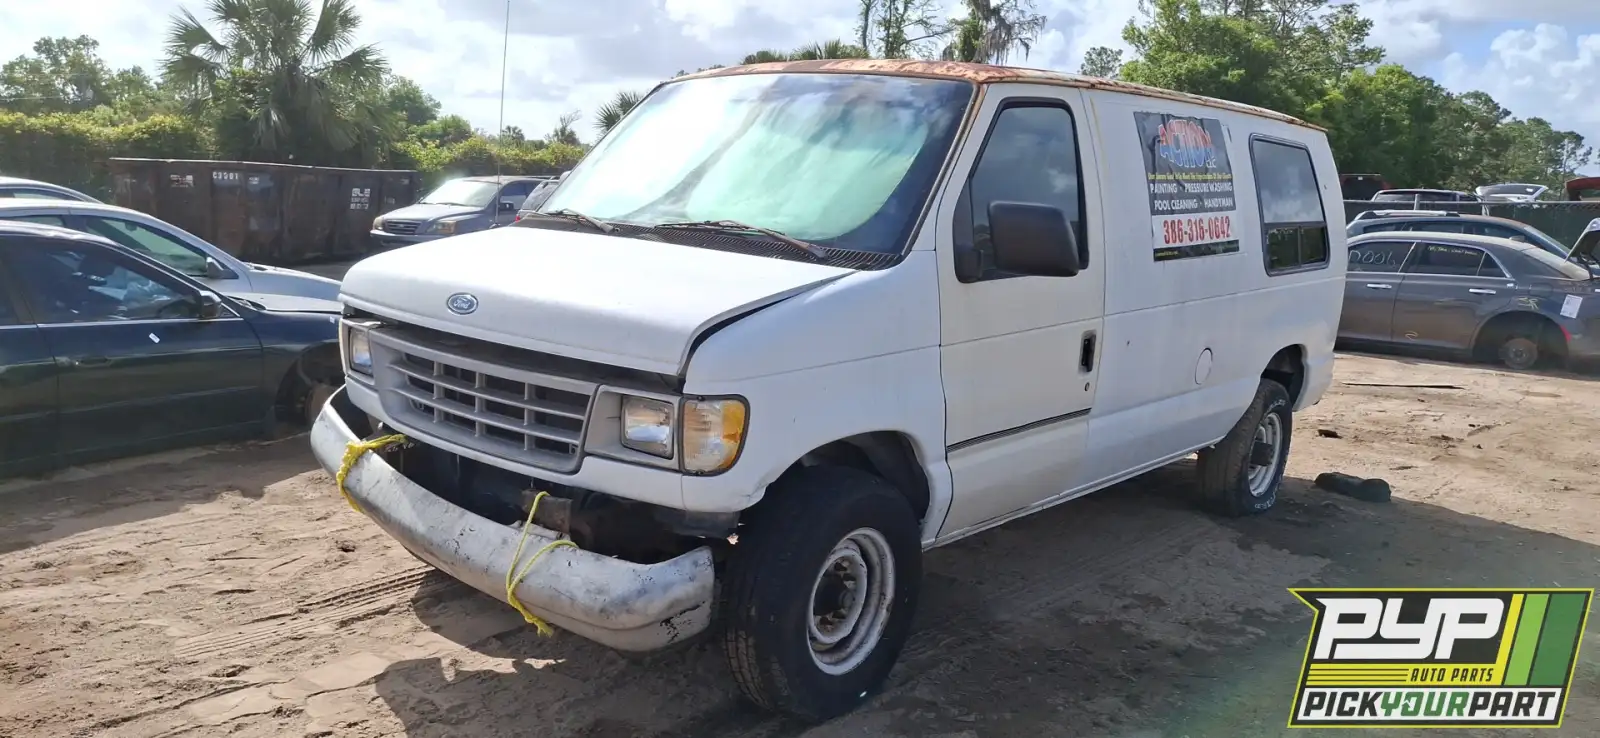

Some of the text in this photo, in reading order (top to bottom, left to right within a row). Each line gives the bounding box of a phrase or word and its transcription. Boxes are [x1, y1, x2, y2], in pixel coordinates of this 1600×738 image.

[1150, 182, 1232, 194] PAINTING PRESSURE WASHING
[1154, 197, 1234, 211] POOL CLEANING HANDYMAN
